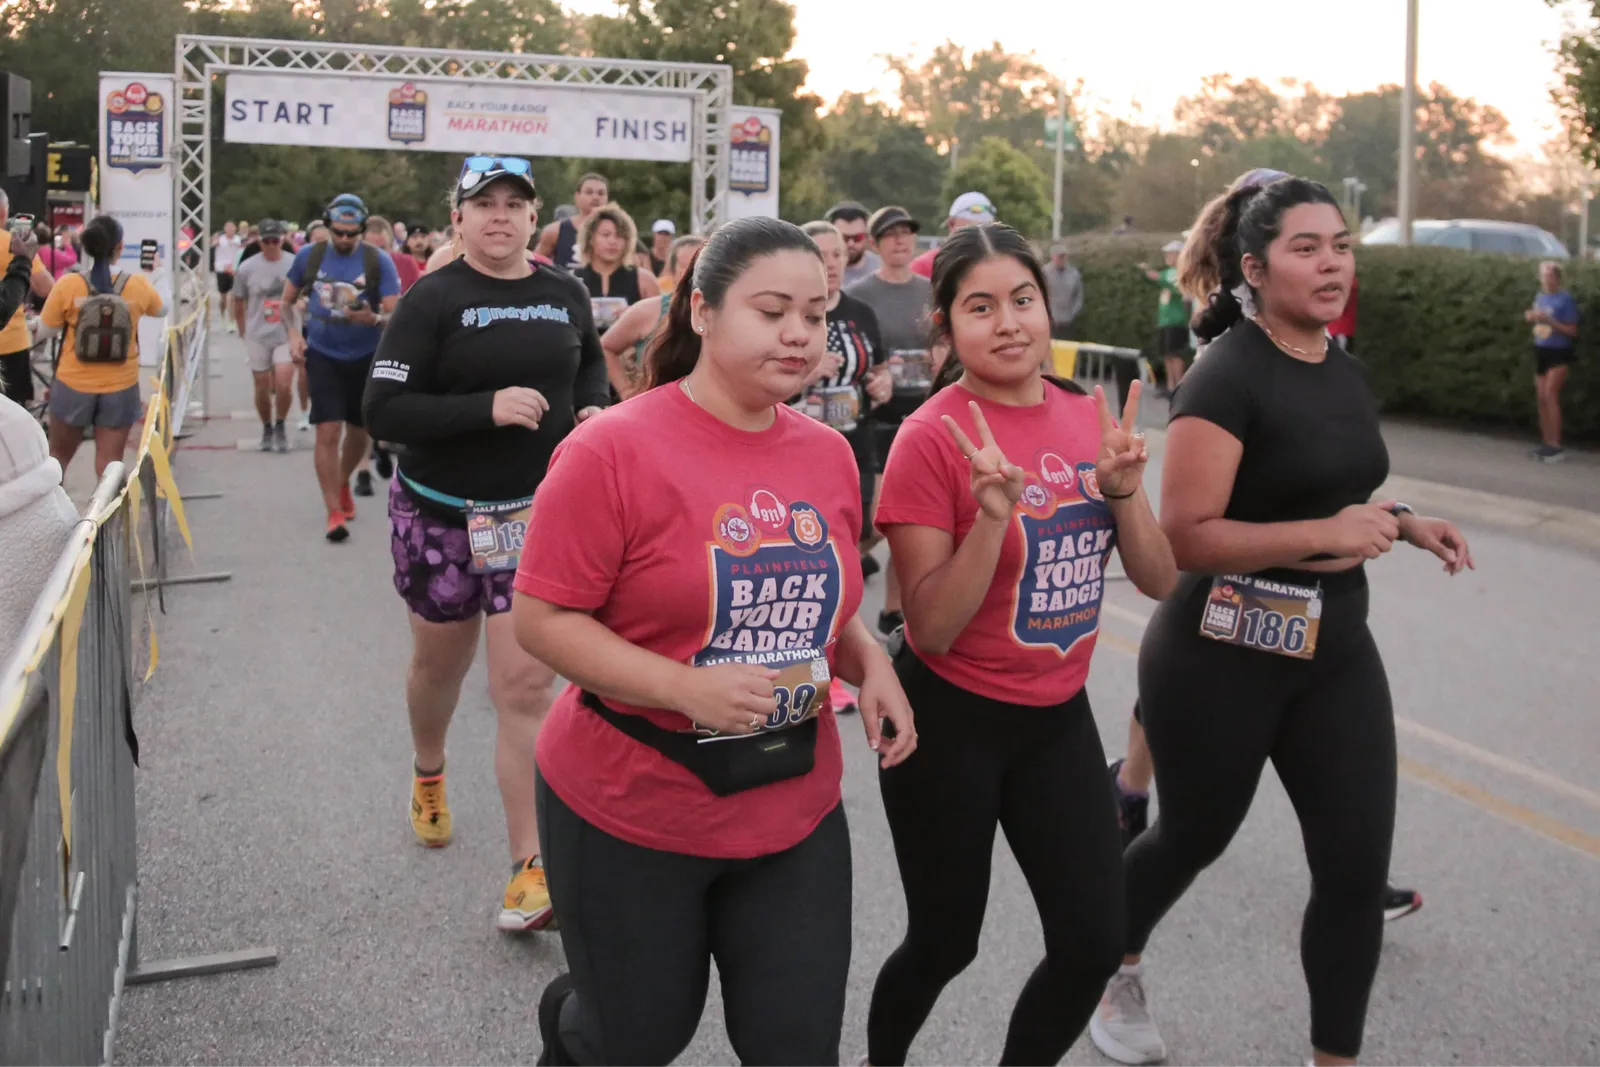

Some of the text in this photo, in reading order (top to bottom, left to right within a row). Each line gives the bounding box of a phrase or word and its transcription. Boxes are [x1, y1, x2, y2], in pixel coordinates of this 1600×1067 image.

[231, 100, 334, 125] START
[111, 121, 159, 133] BACK
[447, 117, 548, 134] MARATHON
[596, 117, 687, 142] FINISH
[111, 133, 159, 146] YOUR
[111, 145, 159, 157] BAGE
[1050, 471, 1070, 484] 911
[473, 505, 496, 513] HALF
[759, 508, 780, 523] 911
[1037, 529, 1112, 564] BACK
[731, 559, 828, 575] PLAINFIELD
[1034, 553, 1102, 590] YOUR
[730, 573, 828, 608] BACK
[1029, 580, 1101, 613] BADGE
[1254, 580, 1318, 598] MARATHON
[728, 601, 822, 631] YOUR
[1028, 606, 1097, 630] MARATHON
[1209, 603, 1236, 616] BACK
[1243, 608, 1308, 653] 186
[711, 629, 814, 652] BADGE
[746, 648, 820, 665] MARATHON
